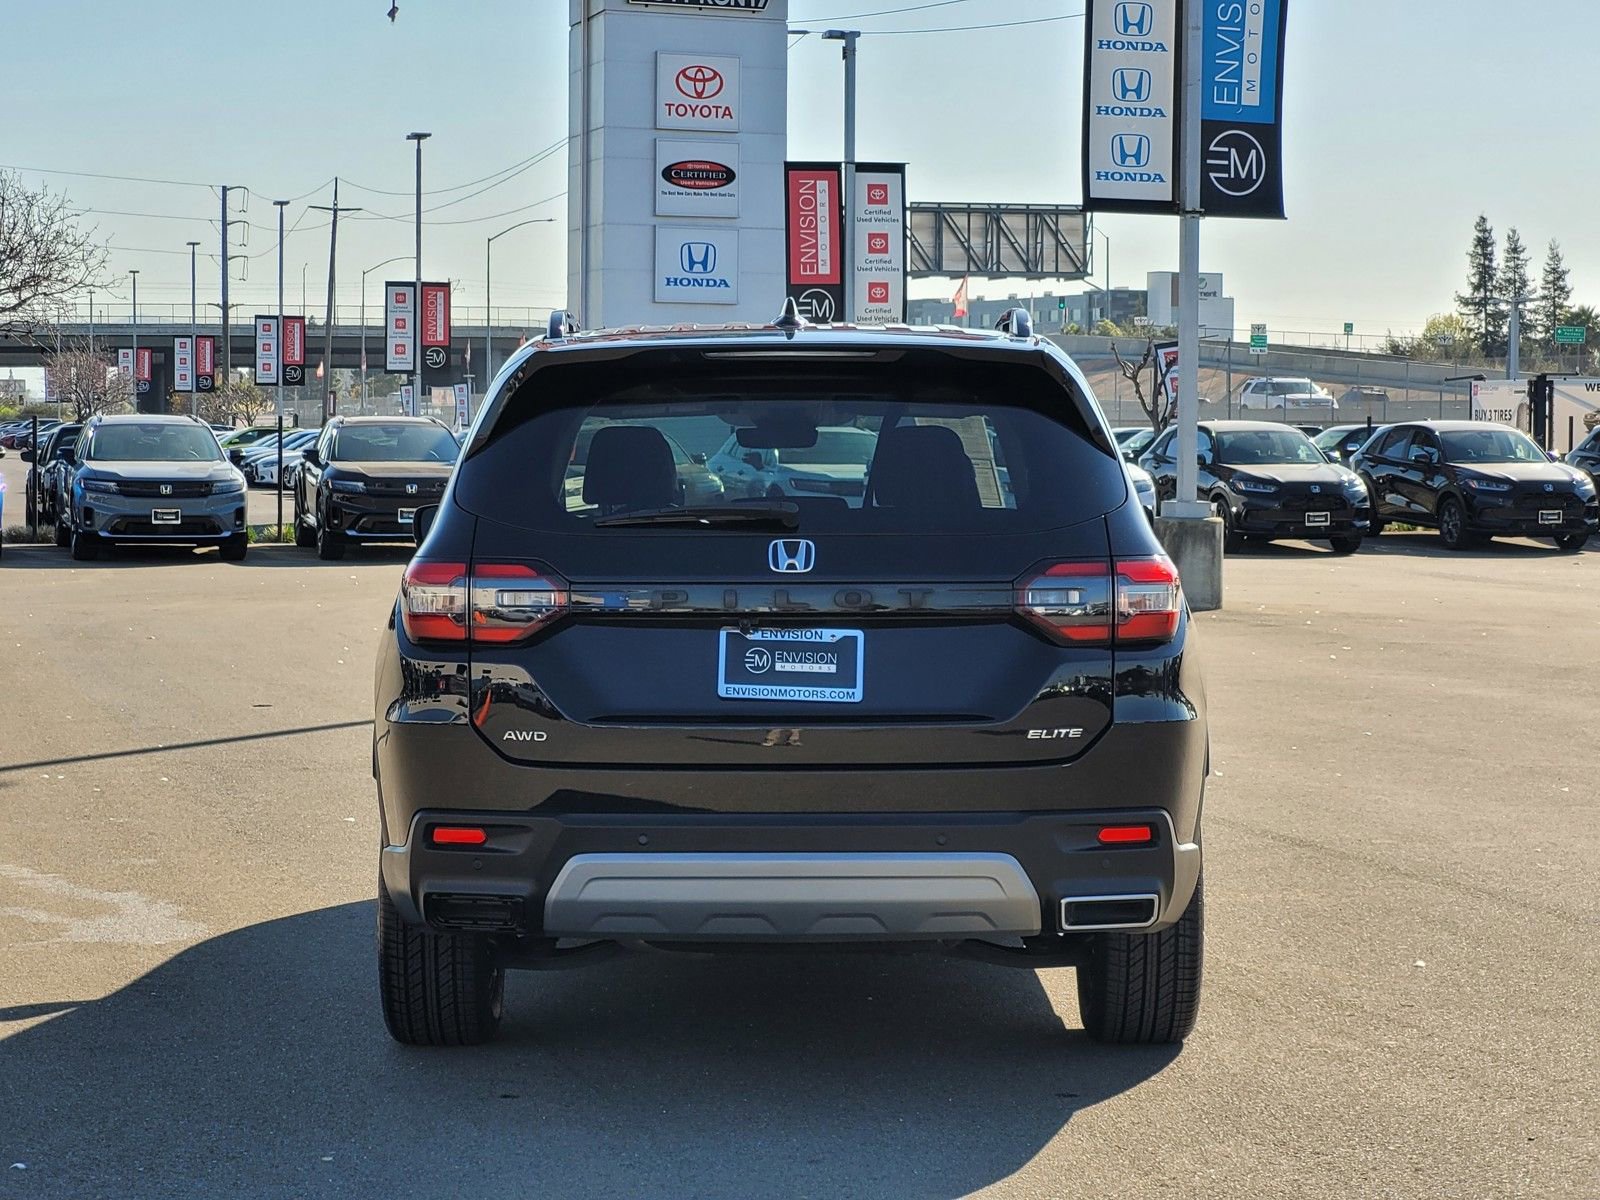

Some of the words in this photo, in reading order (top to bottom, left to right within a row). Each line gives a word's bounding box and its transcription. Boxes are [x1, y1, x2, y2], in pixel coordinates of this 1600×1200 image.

[1097, 39, 1169, 52] HONDA
[664, 103, 733, 119] TOYOTA
[1095, 105, 1167, 118] HONDA
[671, 170, 727, 179] CERTIFIED
[1095, 171, 1167, 183] HONDA
[799, 180, 817, 275] ENVISION
[819, 188, 828, 266] MOTORS
[665, 277, 730, 288] HONDA
[427, 291, 437, 341] ENVISION
[1475, 409, 1487, 421] BUY
[1488, 409, 1493, 421] 3
[1493, 409, 1512, 421] TIRES
[651, 589, 935, 610] PILOT
[761, 630, 823, 640] ENVISION
[775, 651, 837, 664] ENVISION
[725, 686, 855, 700] ENVISIONMOTORS.COM
[503, 730, 548, 741] AWD
[1027, 728, 1083, 739] ELITE
